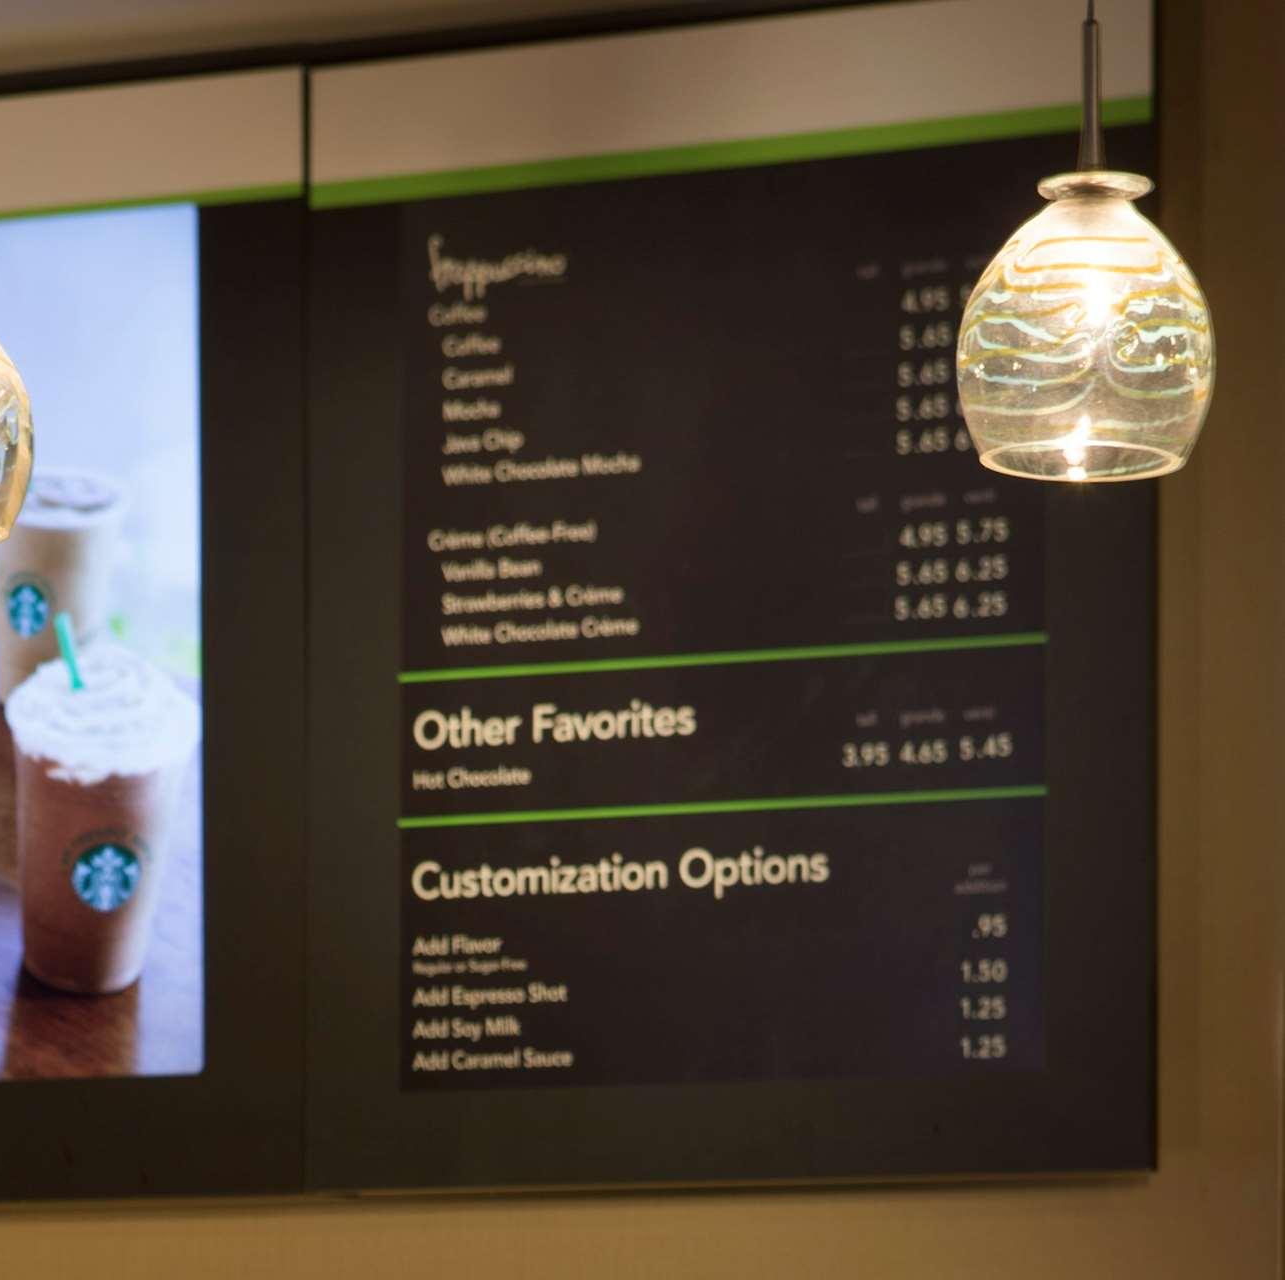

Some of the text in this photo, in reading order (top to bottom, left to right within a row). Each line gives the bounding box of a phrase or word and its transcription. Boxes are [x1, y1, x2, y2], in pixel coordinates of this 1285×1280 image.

[899, 516, 1010, 548] 4.95 5.75
[895, 552, 1009, 587] 5.65 6.25
[894, 589, 1008, 622] 5.65 6.25
[413, 697, 697, 751] Other Favorites
[842, 731, 1013, 768] 3.95 4.65 5.45
[446, 763, 532, 789] Chocolate
[411, 846, 830, 901] Customization Options
[971, 913, 1008, 940] .95
[412, 936, 449, 956] Add
[959, 957, 1009, 984] 1.50
[412, 980, 569, 1011] Add Espresso Shot
[959, 995, 1007, 1021] 1.25
[412, 1014, 521, 1042] Add Soy Milk
[412, 1051, 449, 1071] Add
[522, 1046, 574, 1069] Sauce
[959, 1034, 1007, 1060] 1.25
